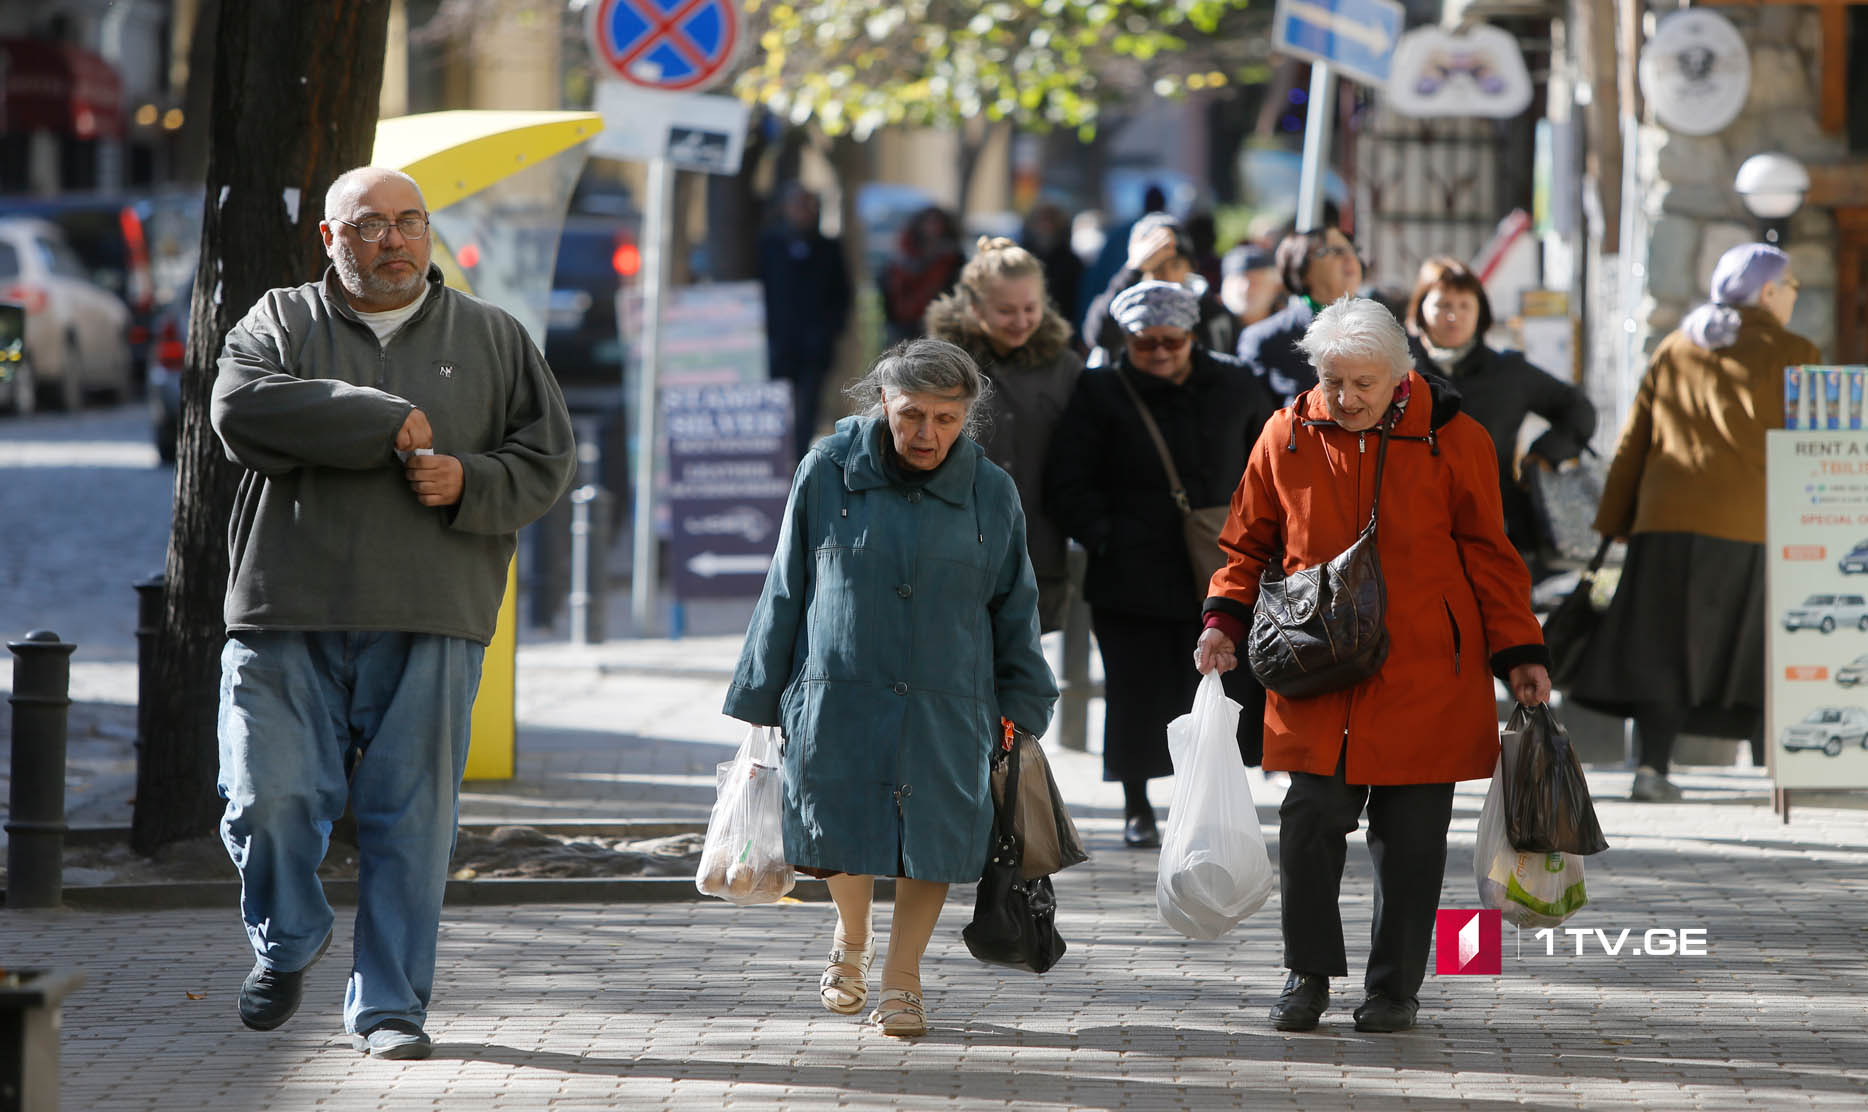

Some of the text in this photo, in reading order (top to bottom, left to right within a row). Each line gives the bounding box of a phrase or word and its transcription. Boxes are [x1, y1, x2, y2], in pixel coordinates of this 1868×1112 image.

[669, 412, 783, 434] SILVER
[1795, 441, 1842, 456] RENT
[1848, 441, 1859, 456] A
[1800, 513, 1852, 526] SPECIAL
